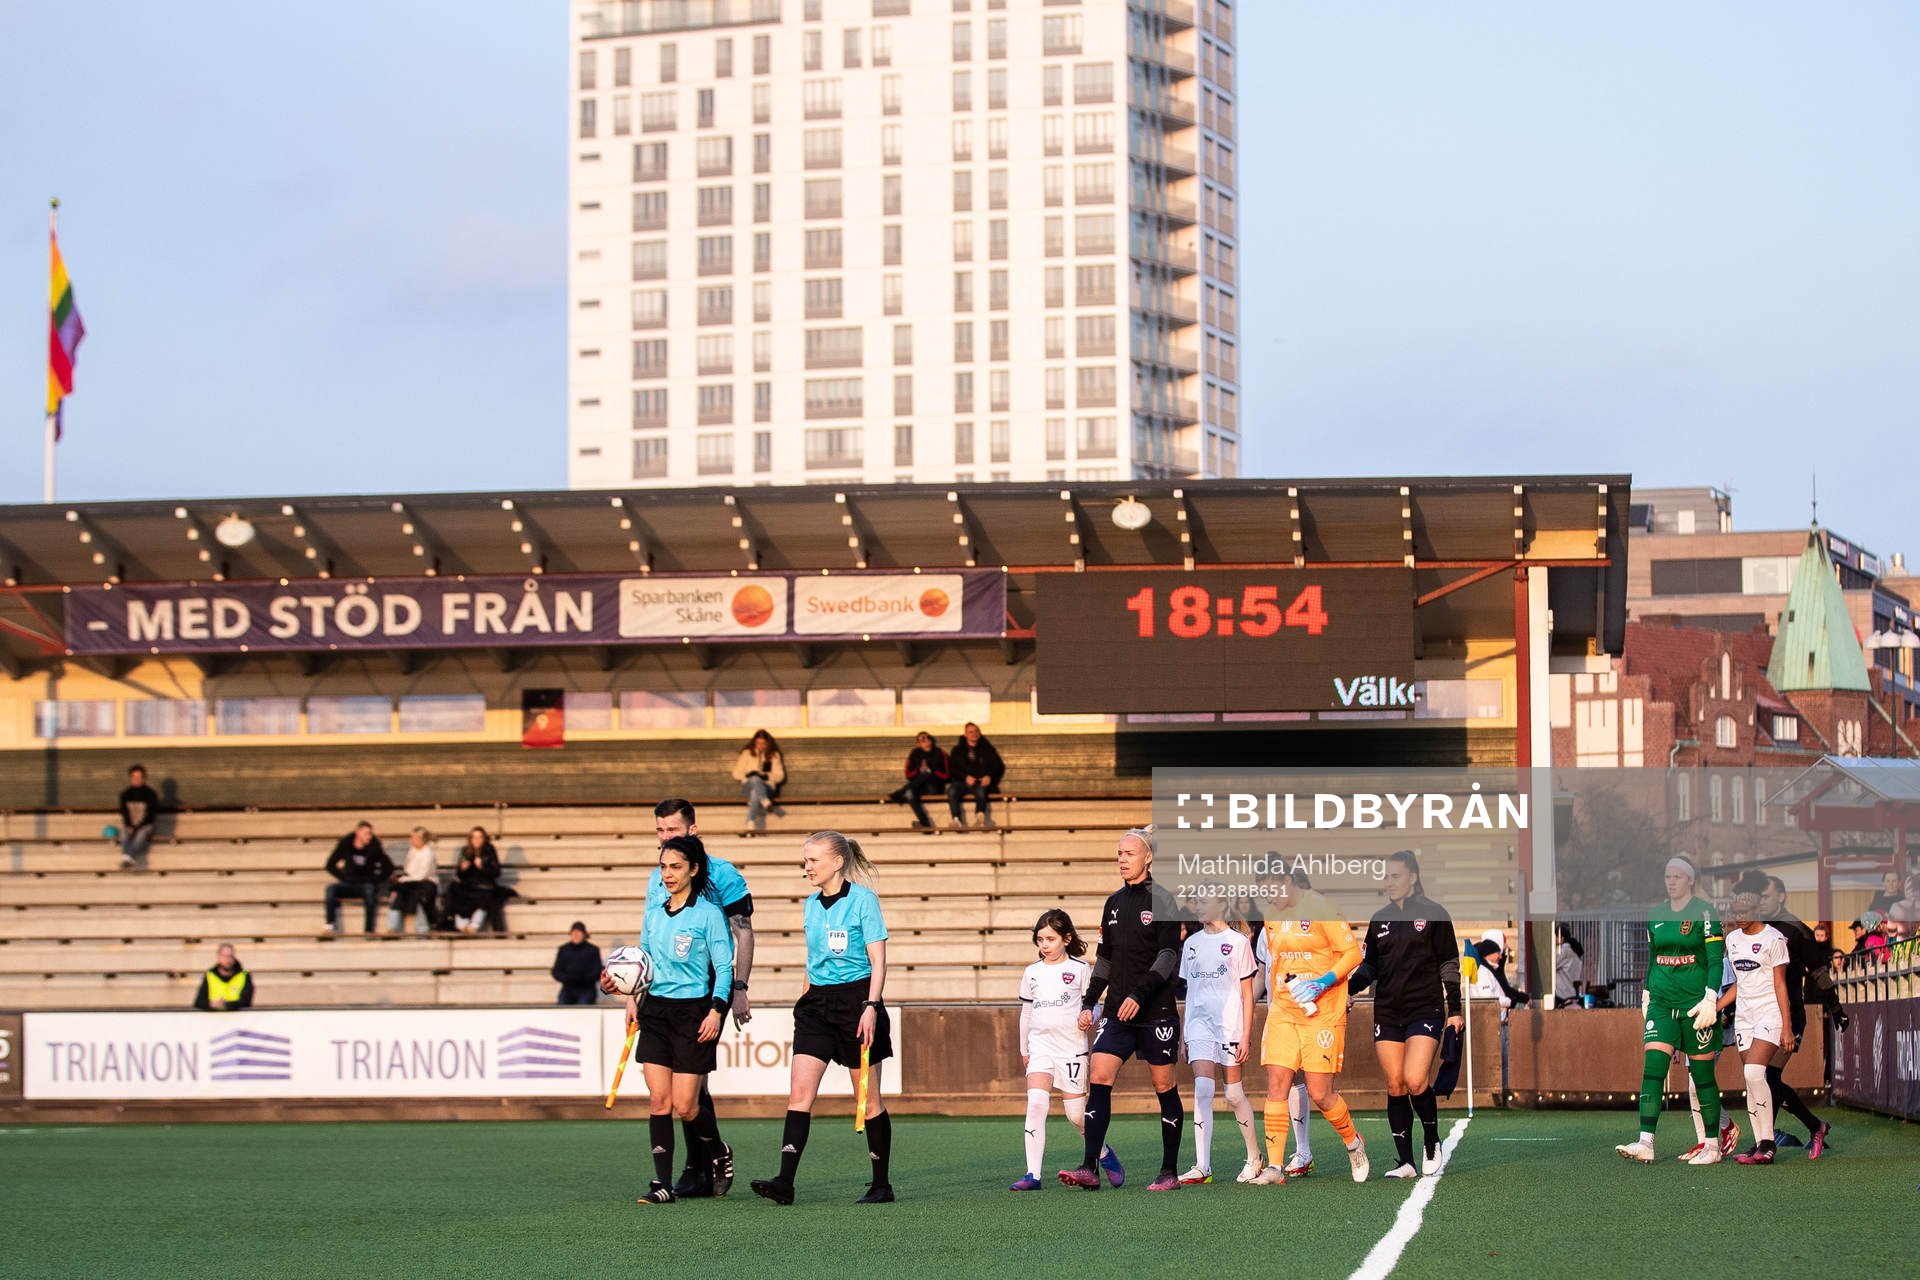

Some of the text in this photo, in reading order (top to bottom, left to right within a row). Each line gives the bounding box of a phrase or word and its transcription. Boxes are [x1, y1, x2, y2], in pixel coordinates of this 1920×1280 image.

[127, 598, 250, 641] MED
[269, 583, 422, 638] STÖD
[442, 578, 593, 635] FRÅN
[631, 589, 723, 606] Sparbanken
[807, 596, 914, 614] Swedbank
[1127, 585, 1328, 638] 18:54
[676, 607, 723, 624] Skåne
[47, 1041, 198, 1081] TRIANON
[331, 1039, 486, 1079] TRIANON
[1066, 1062, 1081, 1079] 17
